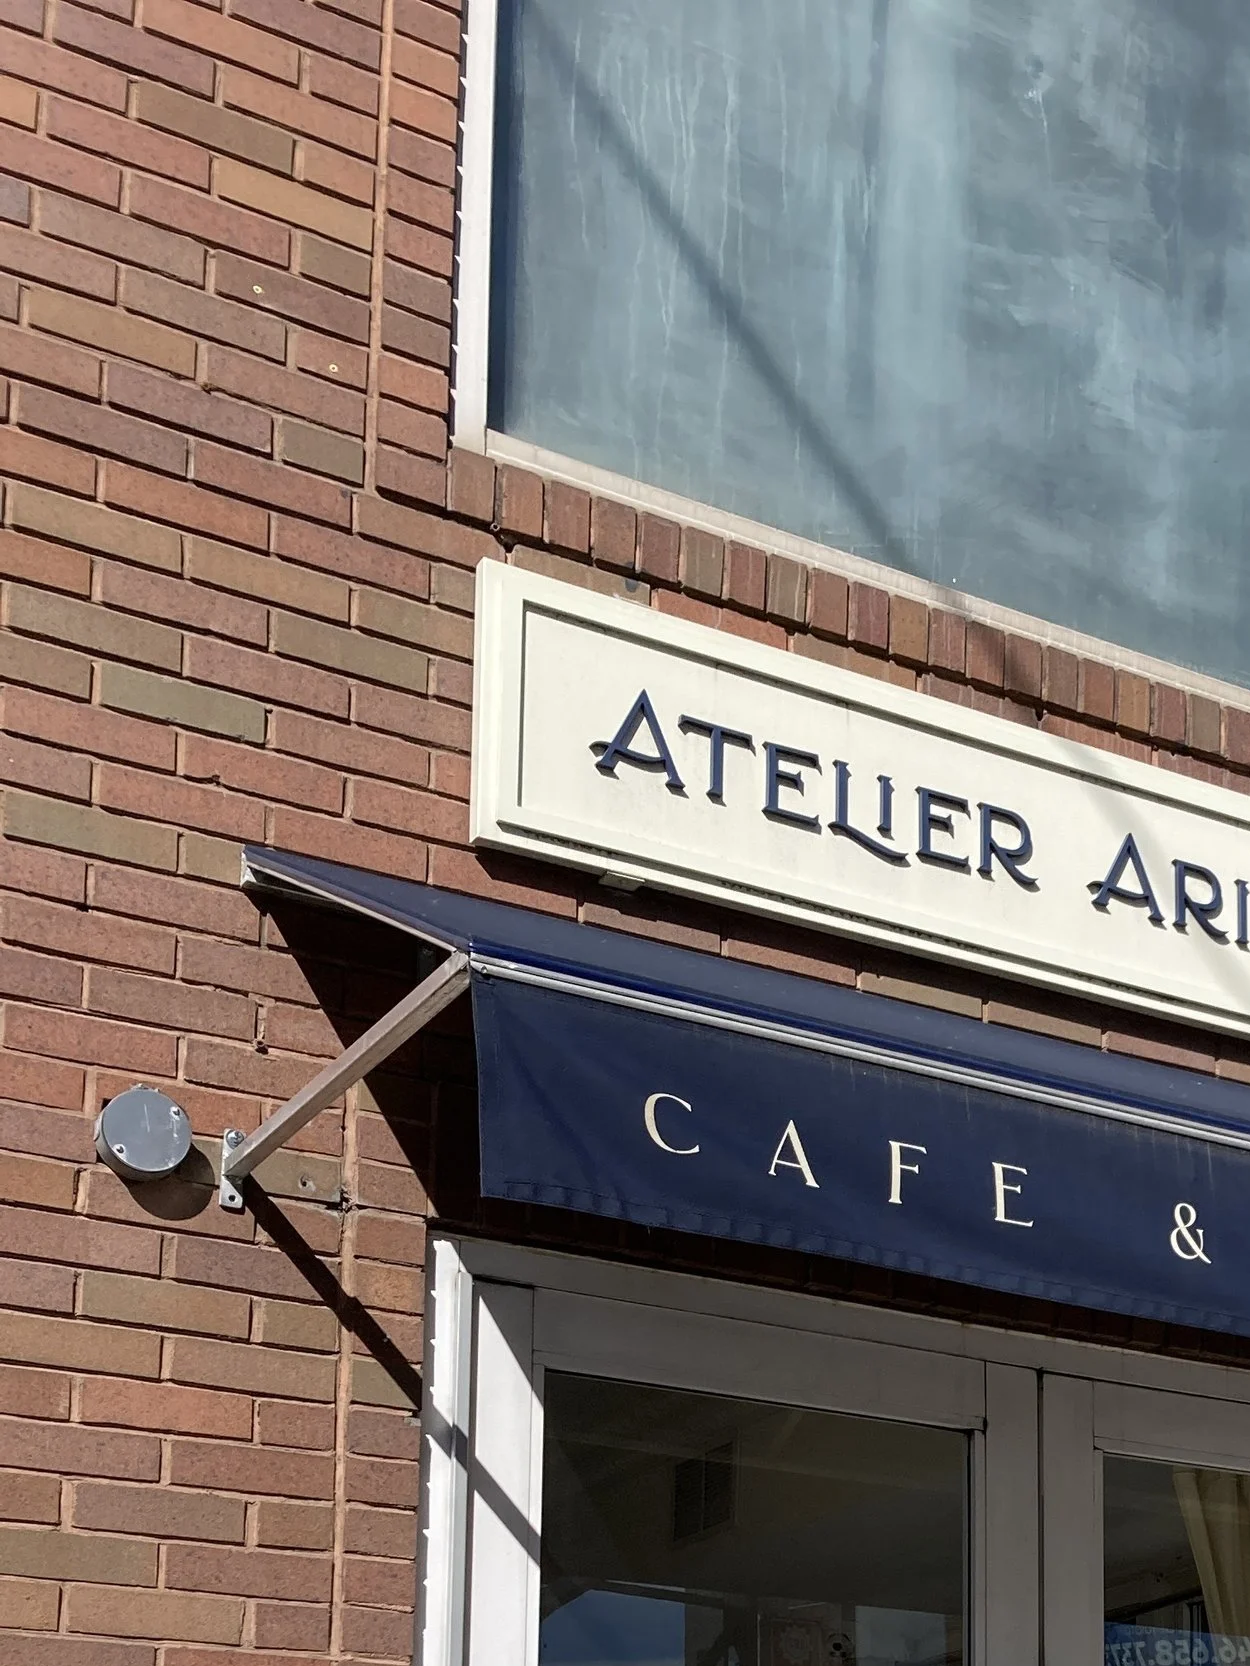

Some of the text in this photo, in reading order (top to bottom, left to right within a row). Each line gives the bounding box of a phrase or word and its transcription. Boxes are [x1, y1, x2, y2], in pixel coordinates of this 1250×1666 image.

[591, 689, 1038, 890] ATELIER
[644, 1092, 1034, 1228] CAFE
[1169, 1203, 1212, 1264] &
